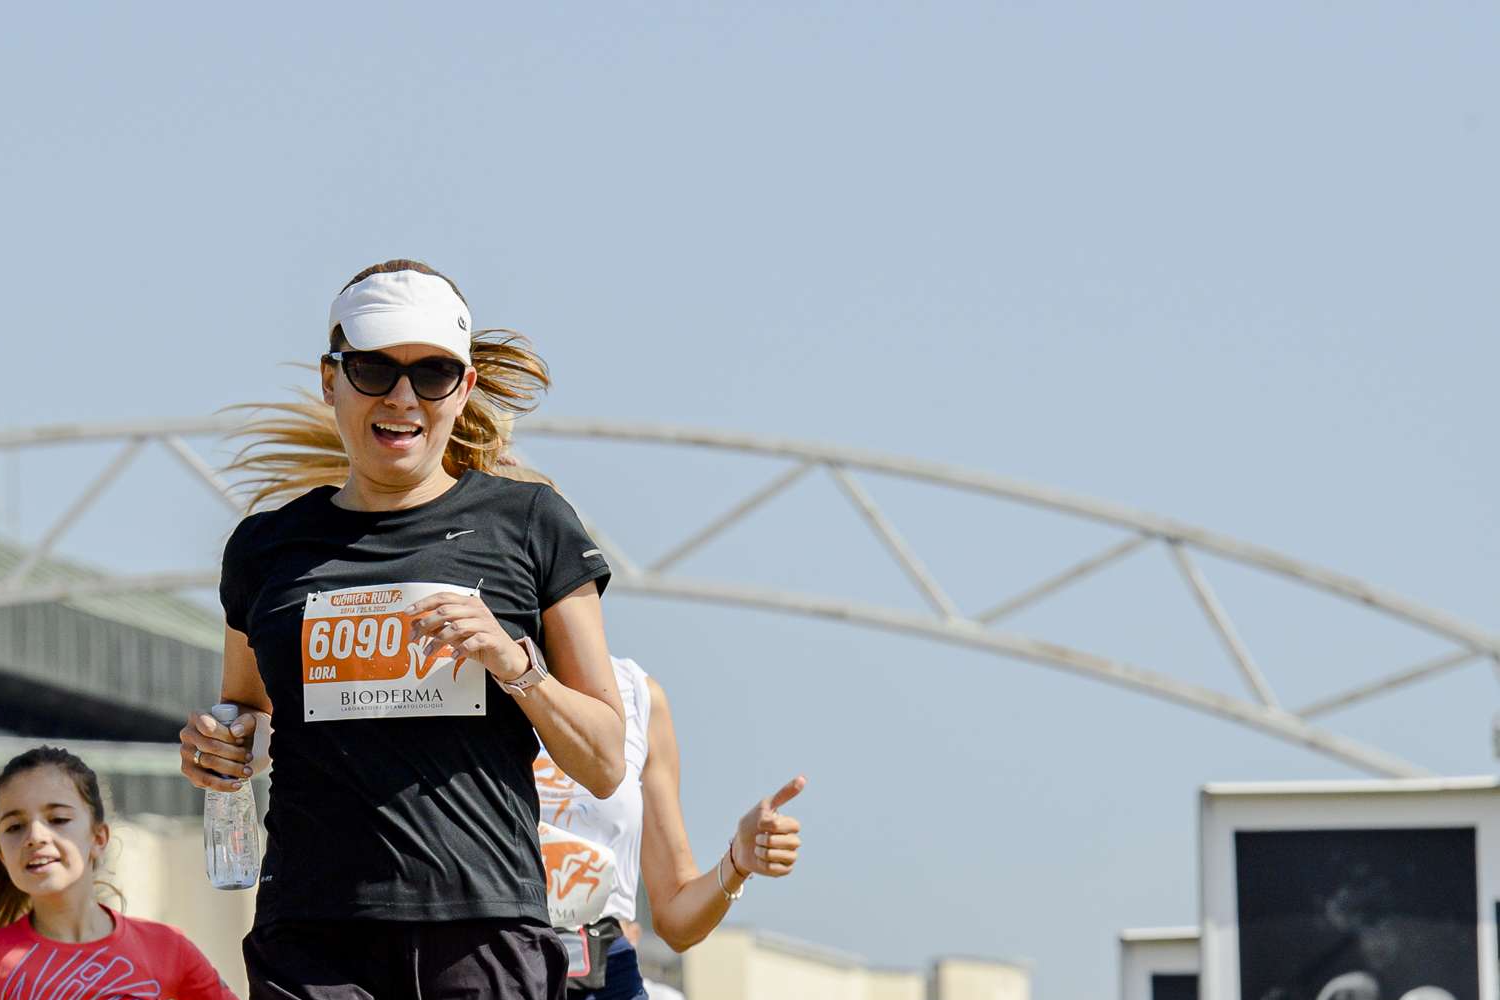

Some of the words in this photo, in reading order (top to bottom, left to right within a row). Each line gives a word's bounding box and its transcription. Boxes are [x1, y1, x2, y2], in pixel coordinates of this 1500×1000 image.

[371, 591, 393, 604] RUN
[308, 617, 403, 661] 6090
[308, 665, 337, 681] LORA
[341, 688, 444, 706] BIODERMA
